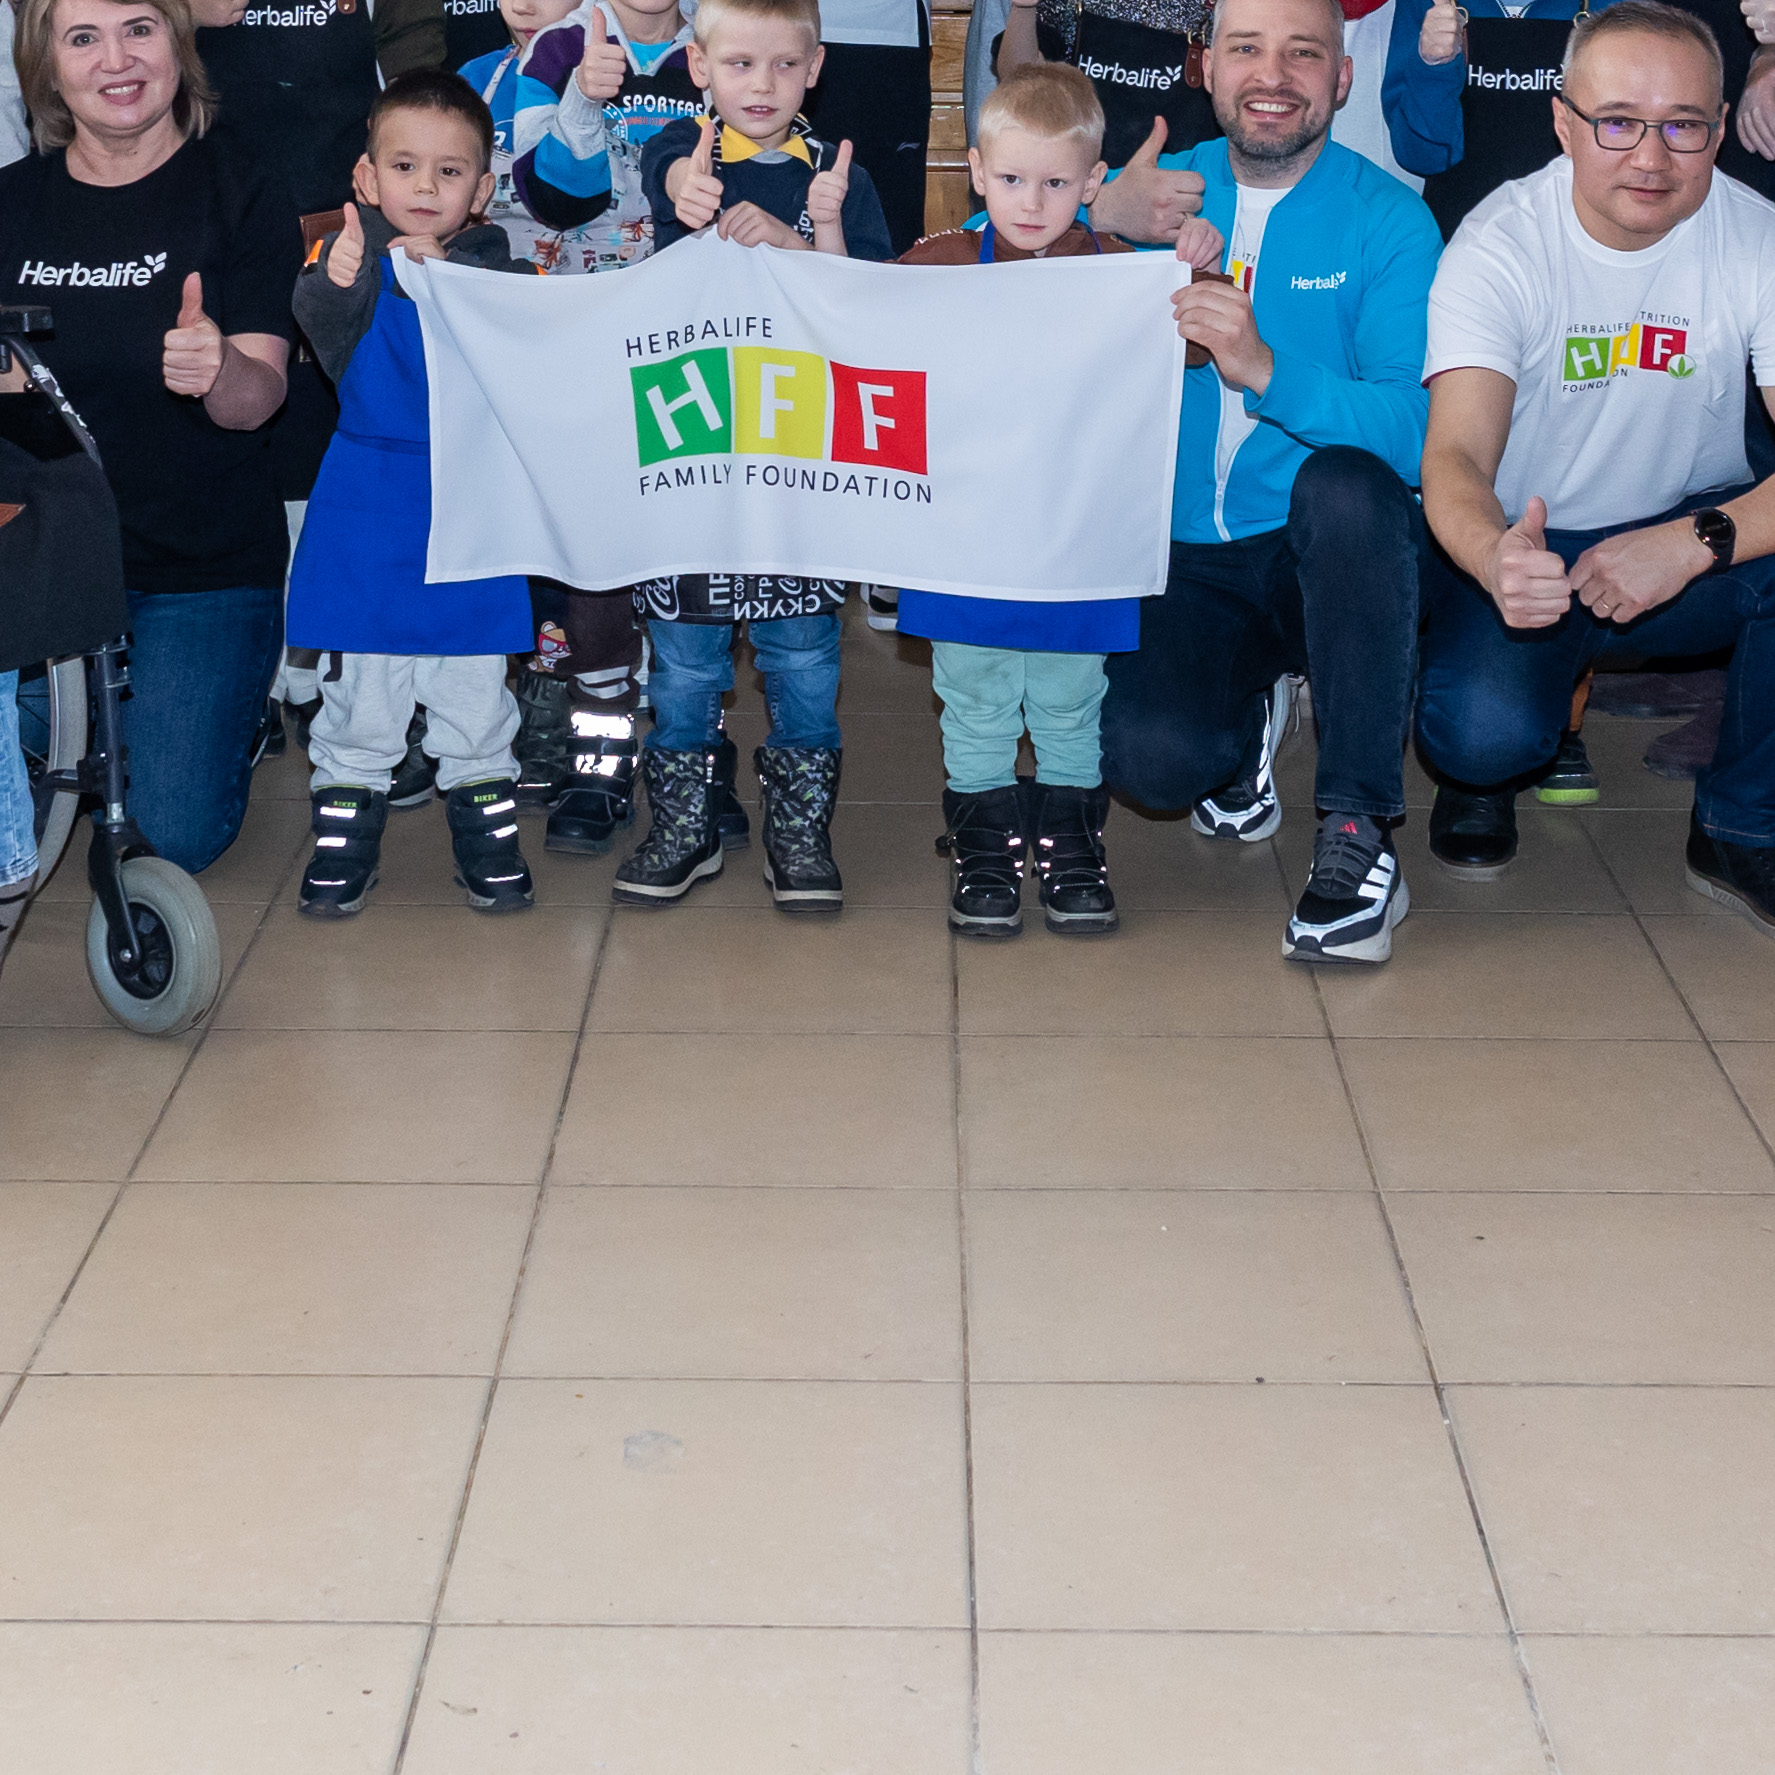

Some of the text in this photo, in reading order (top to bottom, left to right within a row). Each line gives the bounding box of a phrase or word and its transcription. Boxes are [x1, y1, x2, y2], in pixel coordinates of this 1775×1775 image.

[1077, 53, 1172, 90] Herbalife
[1468, 64, 1564, 91] Herbalife
[622, 93, 709, 118] SPORTFAS
[17, 260, 152, 287] Herbalife
[1566, 310, 1691, 335] HERBALIFE TRITION
[625, 316, 773, 359] HERBALIFE
[639, 463, 933, 504] FAMILY FOUNDATION
[333, 800, 358, 809] BIKER
[474, 793, 499, 803] BIKER
